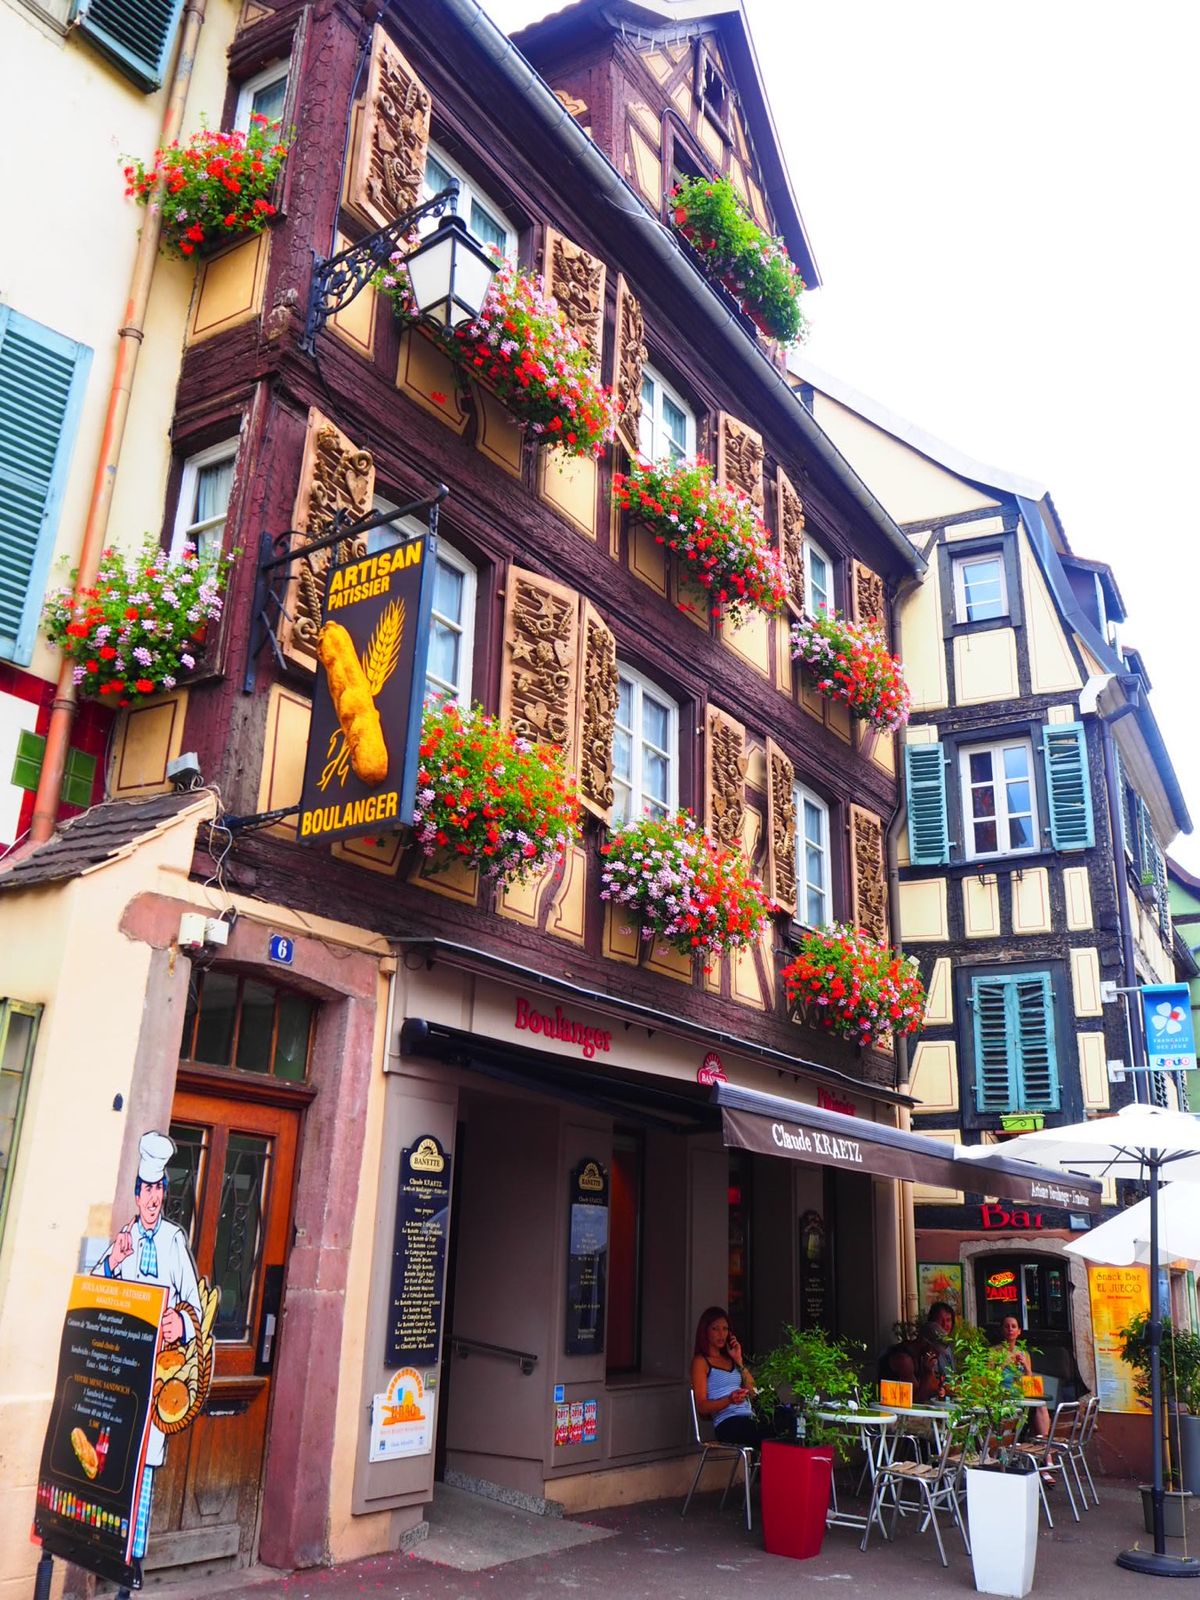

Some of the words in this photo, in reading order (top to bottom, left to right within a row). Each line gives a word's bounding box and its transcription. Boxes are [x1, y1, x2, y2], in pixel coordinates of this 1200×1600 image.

[329, 541, 422, 594] ARTISAN
[327, 575, 390, 611] PATISSIER
[301, 791, 398, 836] BOULANGER
[278, 940, 287, 959] 6
[515, 996, 612, 1058] Boulanger
[772, 1123, 812, 1152] Claude
[812, 1132, 863, 1162] KRAETZ
[414, 1156, 441, 1168] BANETTE
[979, 1203, 1044, 1230] Bar
[1096, 1284, 1106, 1293] EL
[1109, 1283, 1142, 1293] JUEGO
[1097, 1271, 1120, 1281] Snack
[1125, 1272, 1141, 1281] Bar
